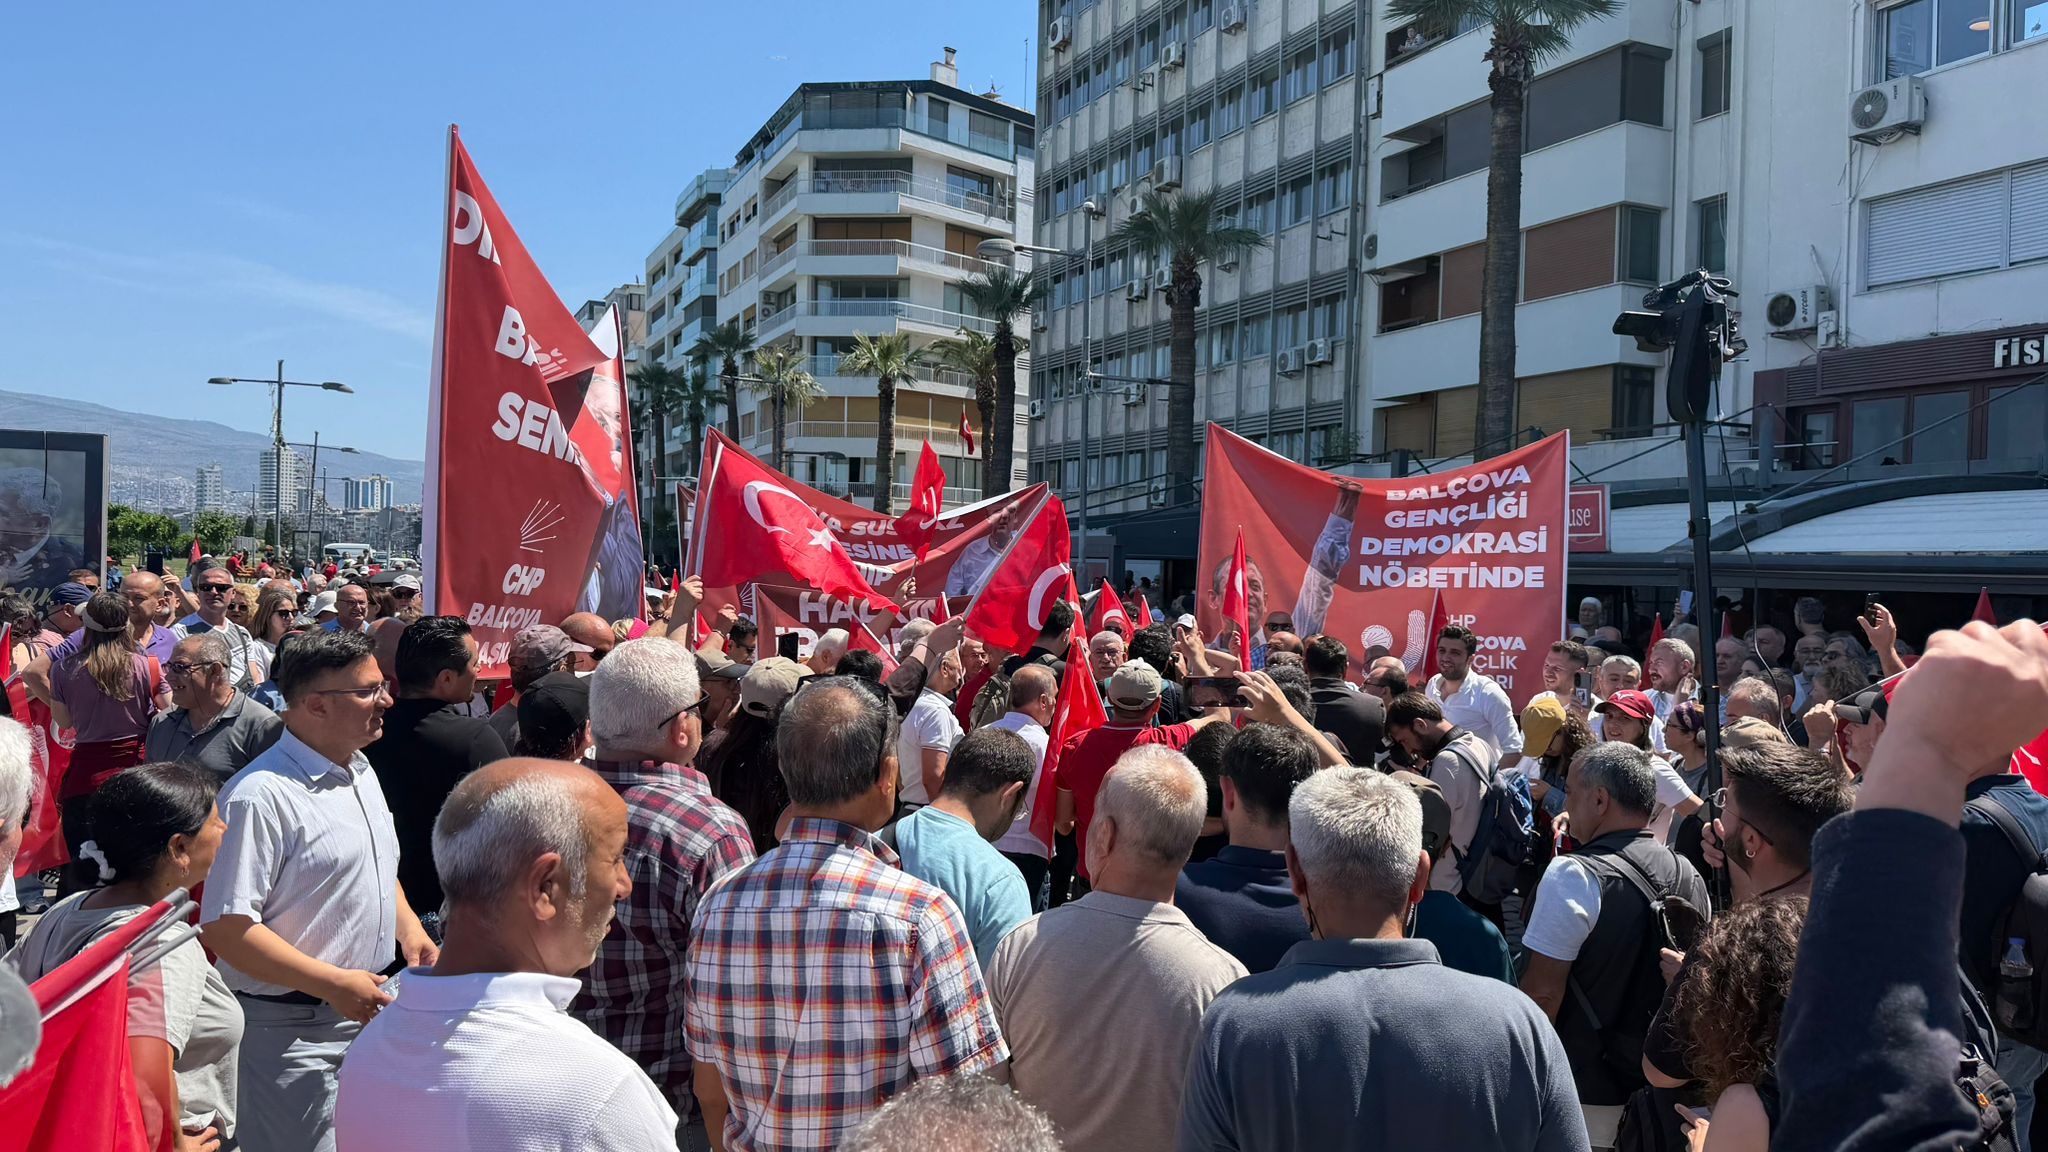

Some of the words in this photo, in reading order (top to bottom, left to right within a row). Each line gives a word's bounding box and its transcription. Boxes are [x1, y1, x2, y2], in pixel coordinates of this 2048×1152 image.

[1386, 464, 1532, 501] BALÇOVA
[1384, 490, 1529, 528] GENÇLİĞİ
[839, 541, 916, 560] ESİNE
[1360, 525, 1548, 556] DEMOKRASİ
[502, 563, 546, 596] CHP
[1359, 561, 1545, 589] NÖBETİNDE
[467, 602, 542, 633] BALÇOVA
[1446, 614, 1477, 630] HP
[1475, 636, 1527, 652] ÇOVA
[1472, 652, 1518, 673] ÇLİK
